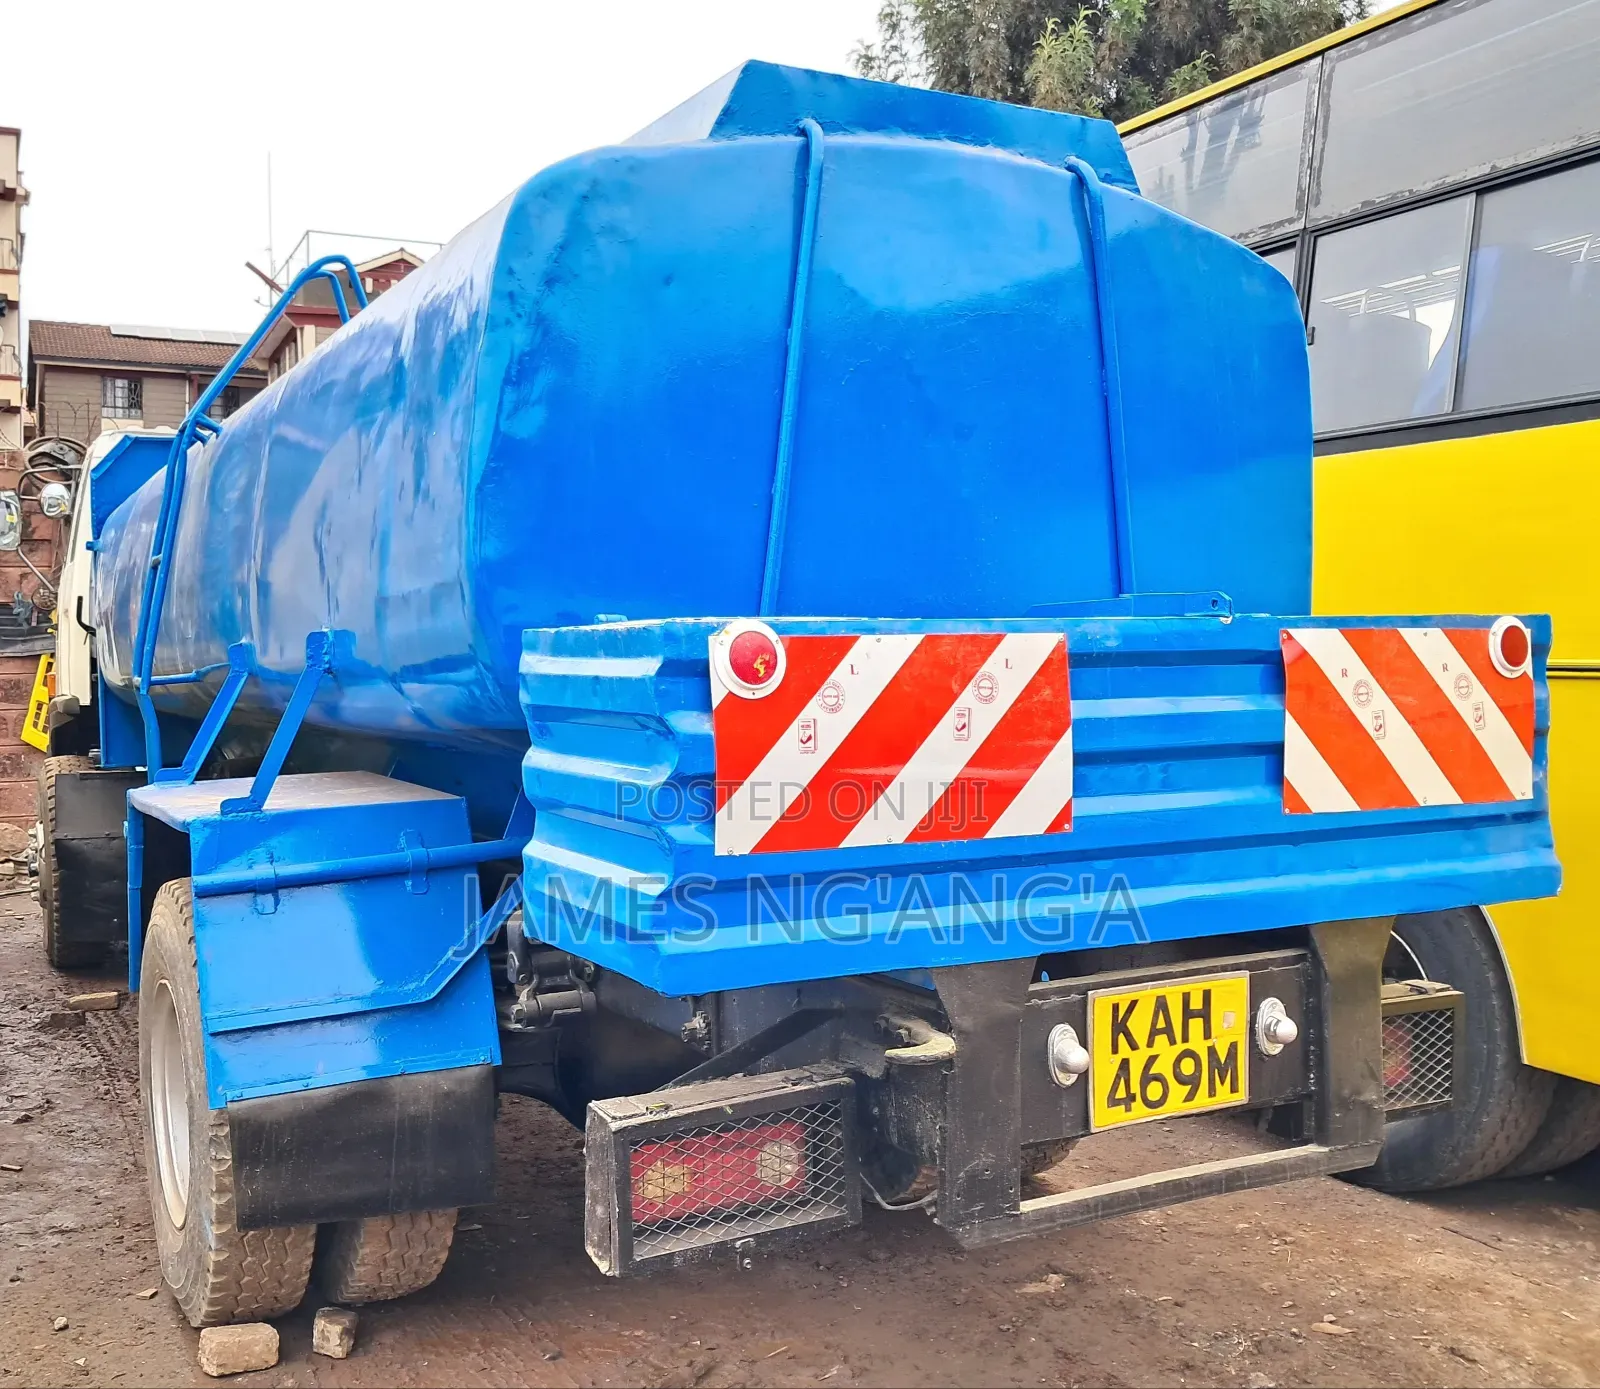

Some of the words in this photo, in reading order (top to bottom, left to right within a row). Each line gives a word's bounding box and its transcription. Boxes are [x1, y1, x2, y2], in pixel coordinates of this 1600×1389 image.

[1005, 658, 1013, 669] L
[1442, 662, 1449, 672] R
[849, 664, 859, 675] L
[1341, 668, 1348, 678] R
[1111, 989, 1211, 1055] KAH
[1107, 1041, 1240, 1112] 469M
